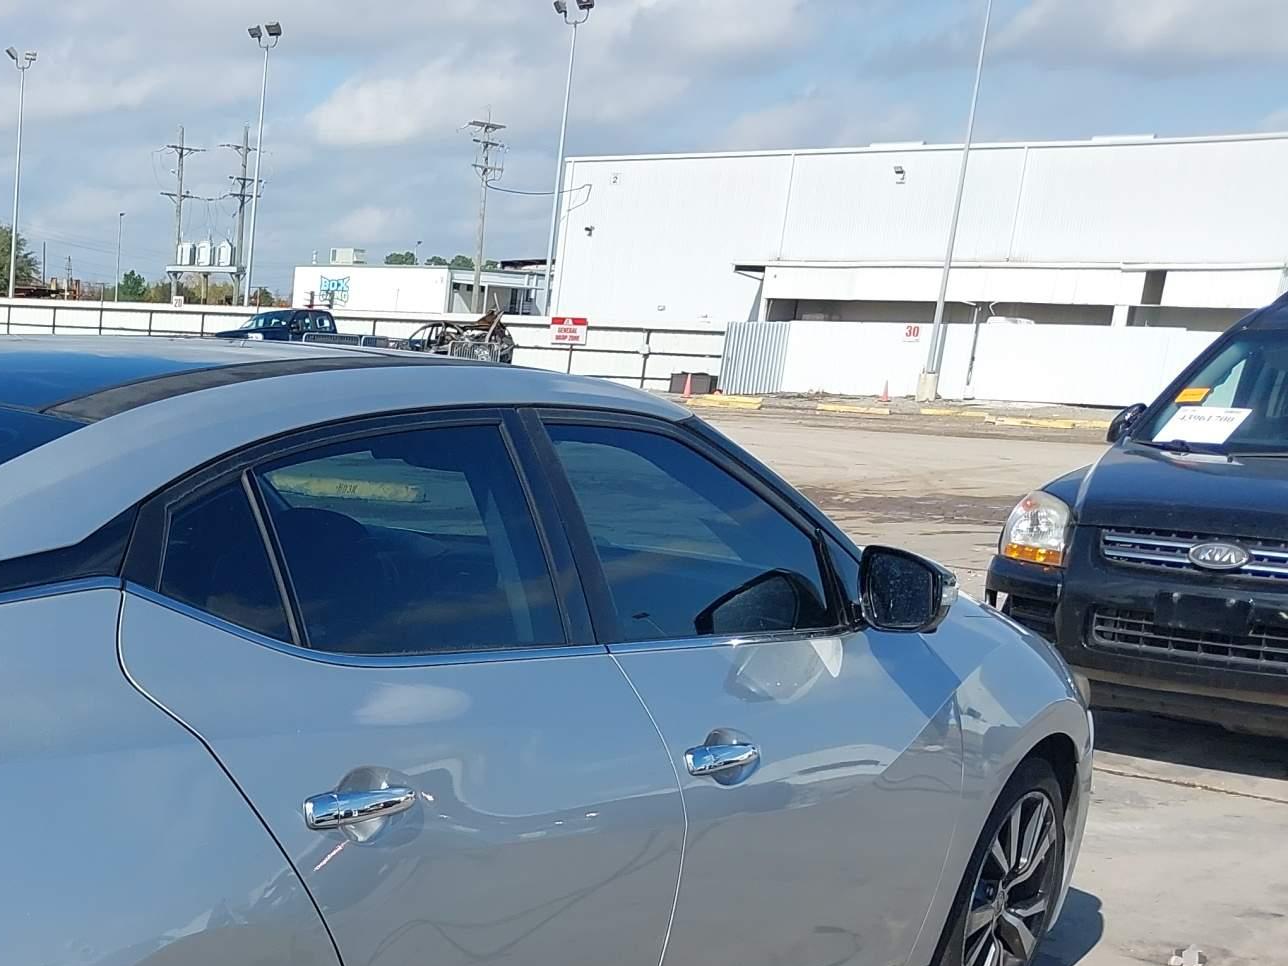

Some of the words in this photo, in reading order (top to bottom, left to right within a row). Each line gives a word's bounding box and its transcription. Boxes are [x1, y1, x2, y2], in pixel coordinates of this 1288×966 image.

[320, 275, 350, 291] BOX
[905, 325, 920, 338] 30
[1198, 547, 1236, 564] KIA
